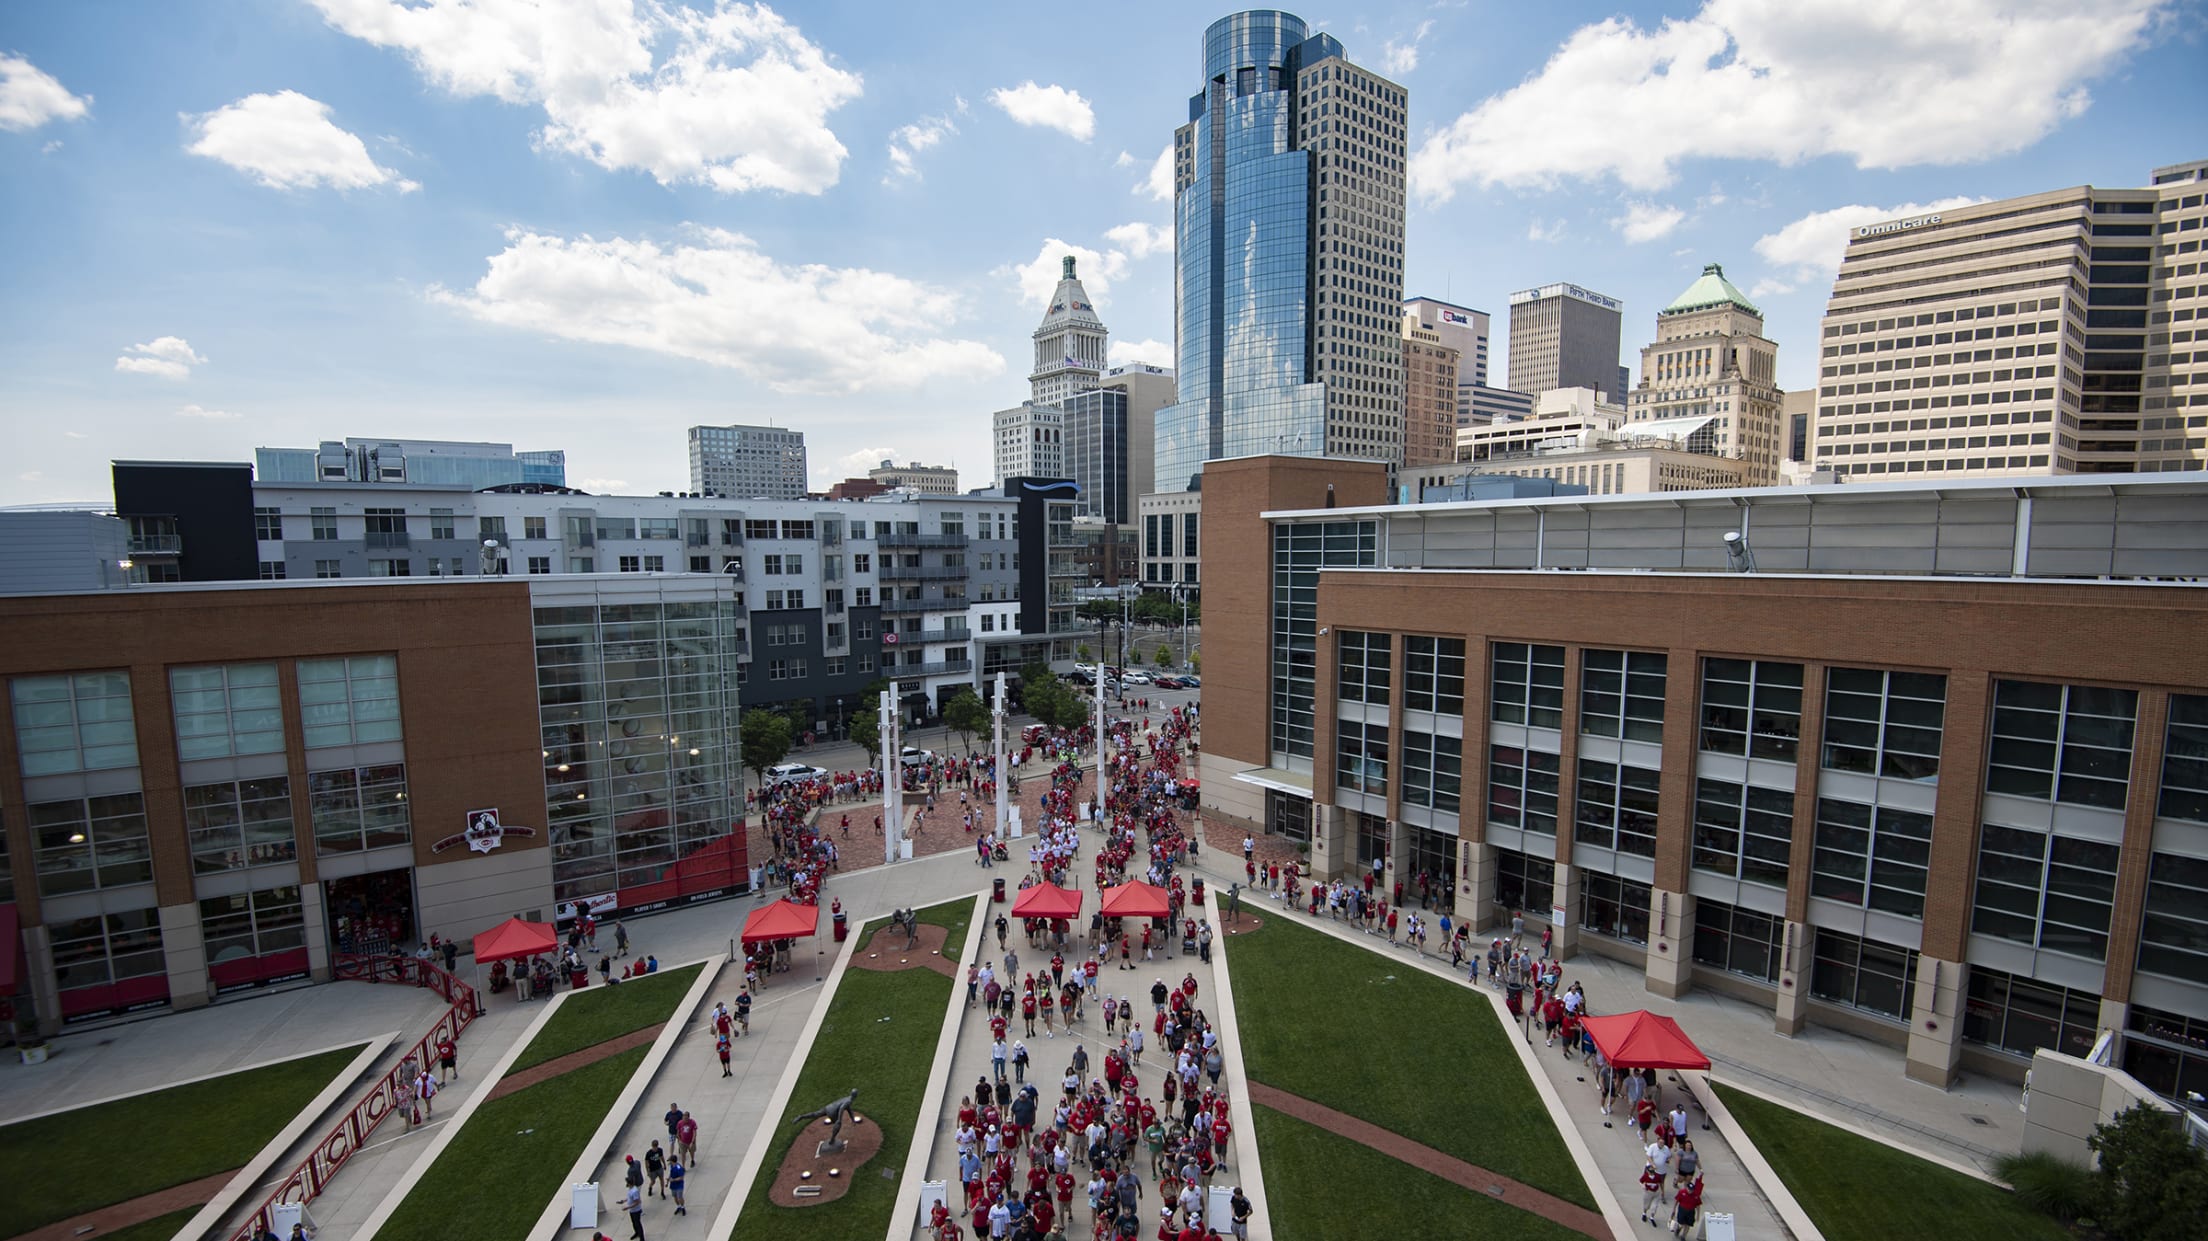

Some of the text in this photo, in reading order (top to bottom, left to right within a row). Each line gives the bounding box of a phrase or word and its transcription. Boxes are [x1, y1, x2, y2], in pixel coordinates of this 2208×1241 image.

[1860, 214, 1941, 237] Omnicare
[1569, 286, 1617, 309] FIFTH THIRD BANK
[470, 827, 500, 840] TEAM
